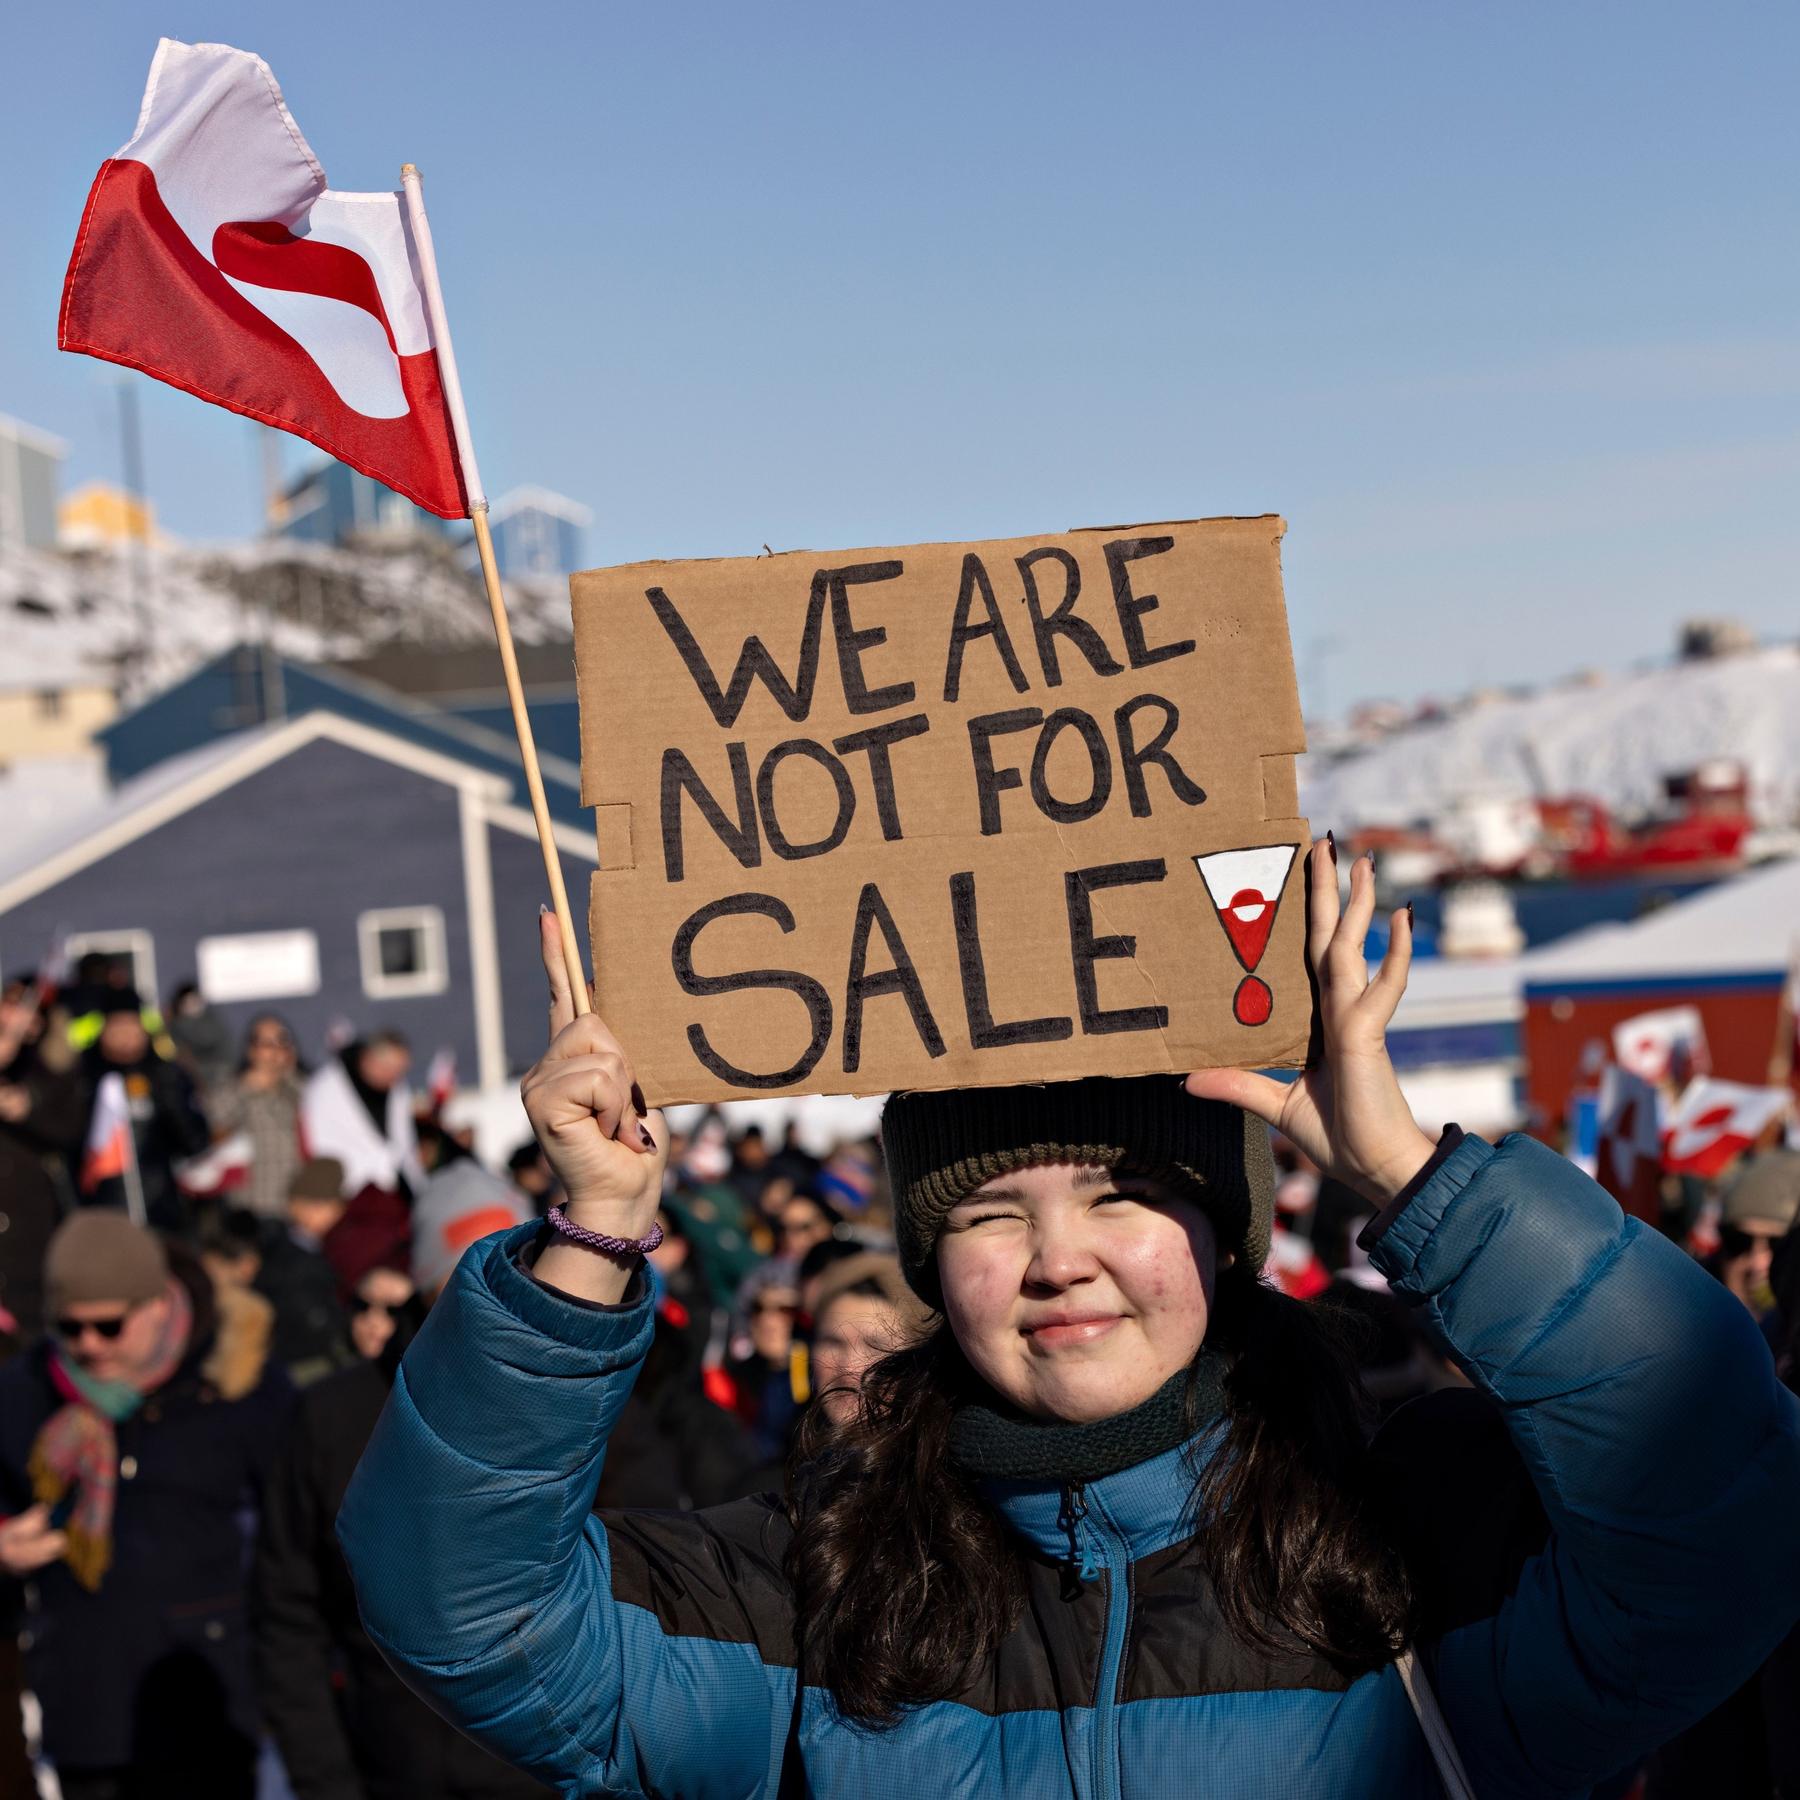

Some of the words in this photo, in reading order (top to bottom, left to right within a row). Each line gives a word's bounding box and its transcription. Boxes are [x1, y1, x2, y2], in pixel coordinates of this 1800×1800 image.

[645, 560, 916, 729] WE
[944, 536, 1197, 704] ARE
[660, 713, 931, 883] NOT
[967, 693, 1208, 836] FOR
